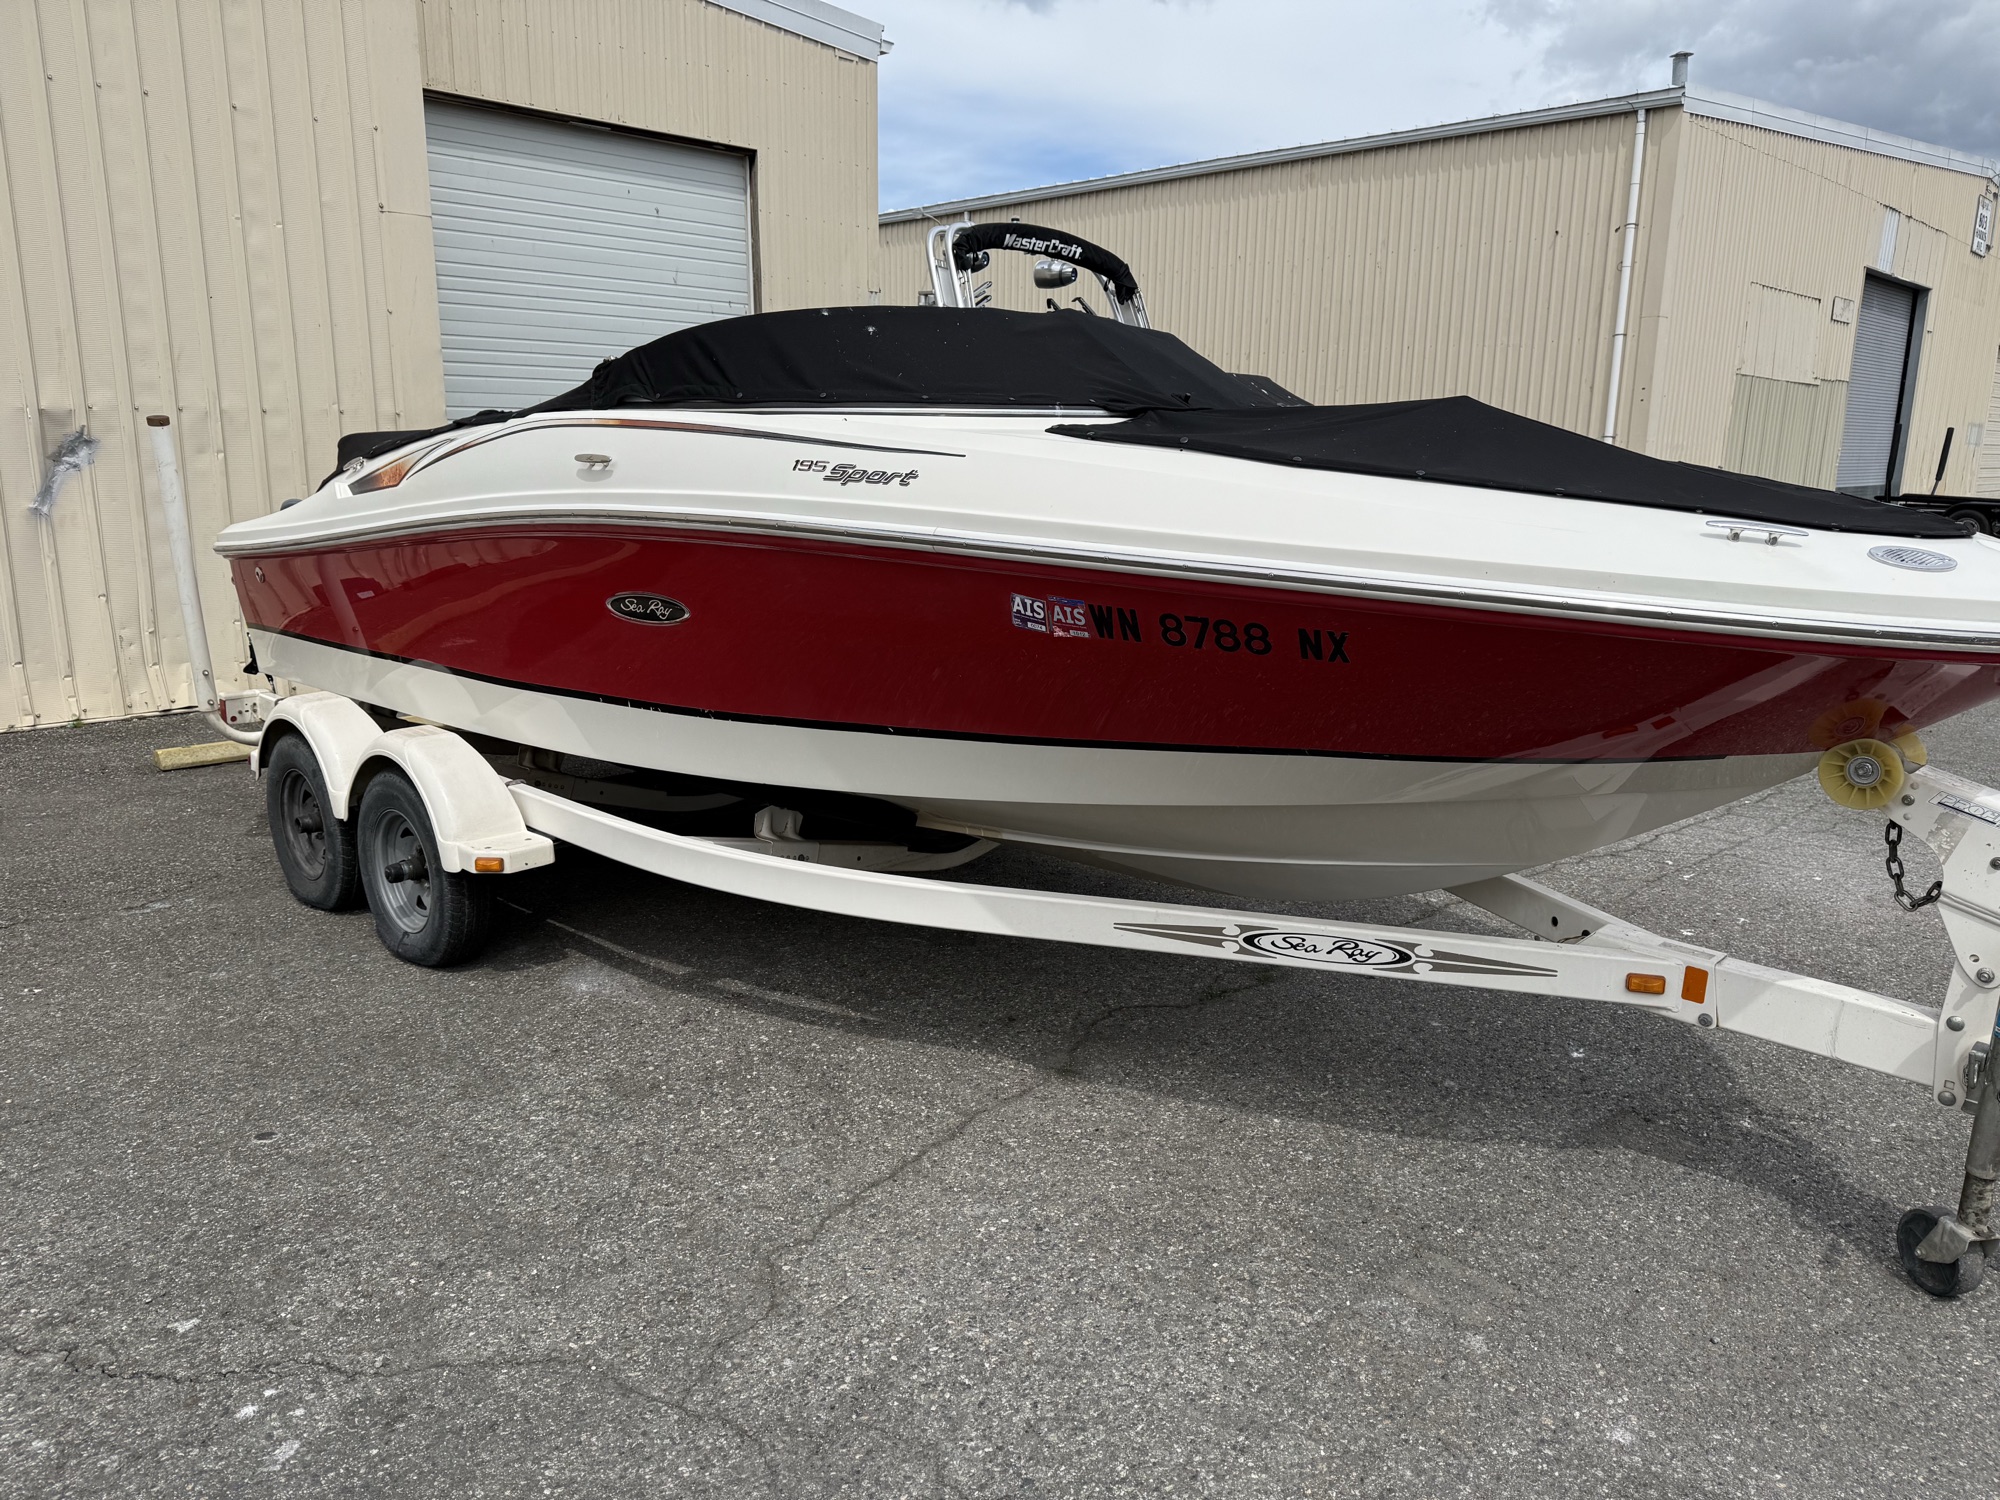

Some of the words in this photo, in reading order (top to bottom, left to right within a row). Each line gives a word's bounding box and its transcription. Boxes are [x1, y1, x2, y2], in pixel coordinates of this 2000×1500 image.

[1003, 233, 1083, 260] MasterCraft
[792, 459, 829, 472] 195
[822, 463, 918, 487] Sport
[620, 598, 645, 613] Sea
[647, 600, 673, 618] Ray
[1013, 597, 1045, 619] AIS
[1053, 605, 1086, 626] AIS
[1088, 604, 1142, 642] WN
[1158, 613, 1273, 655] 8788
[1298, 628, 1350, 663] NX
[1271, 935, 1323, 955] Sea
[1326, 940, 1383, 962] Ray
